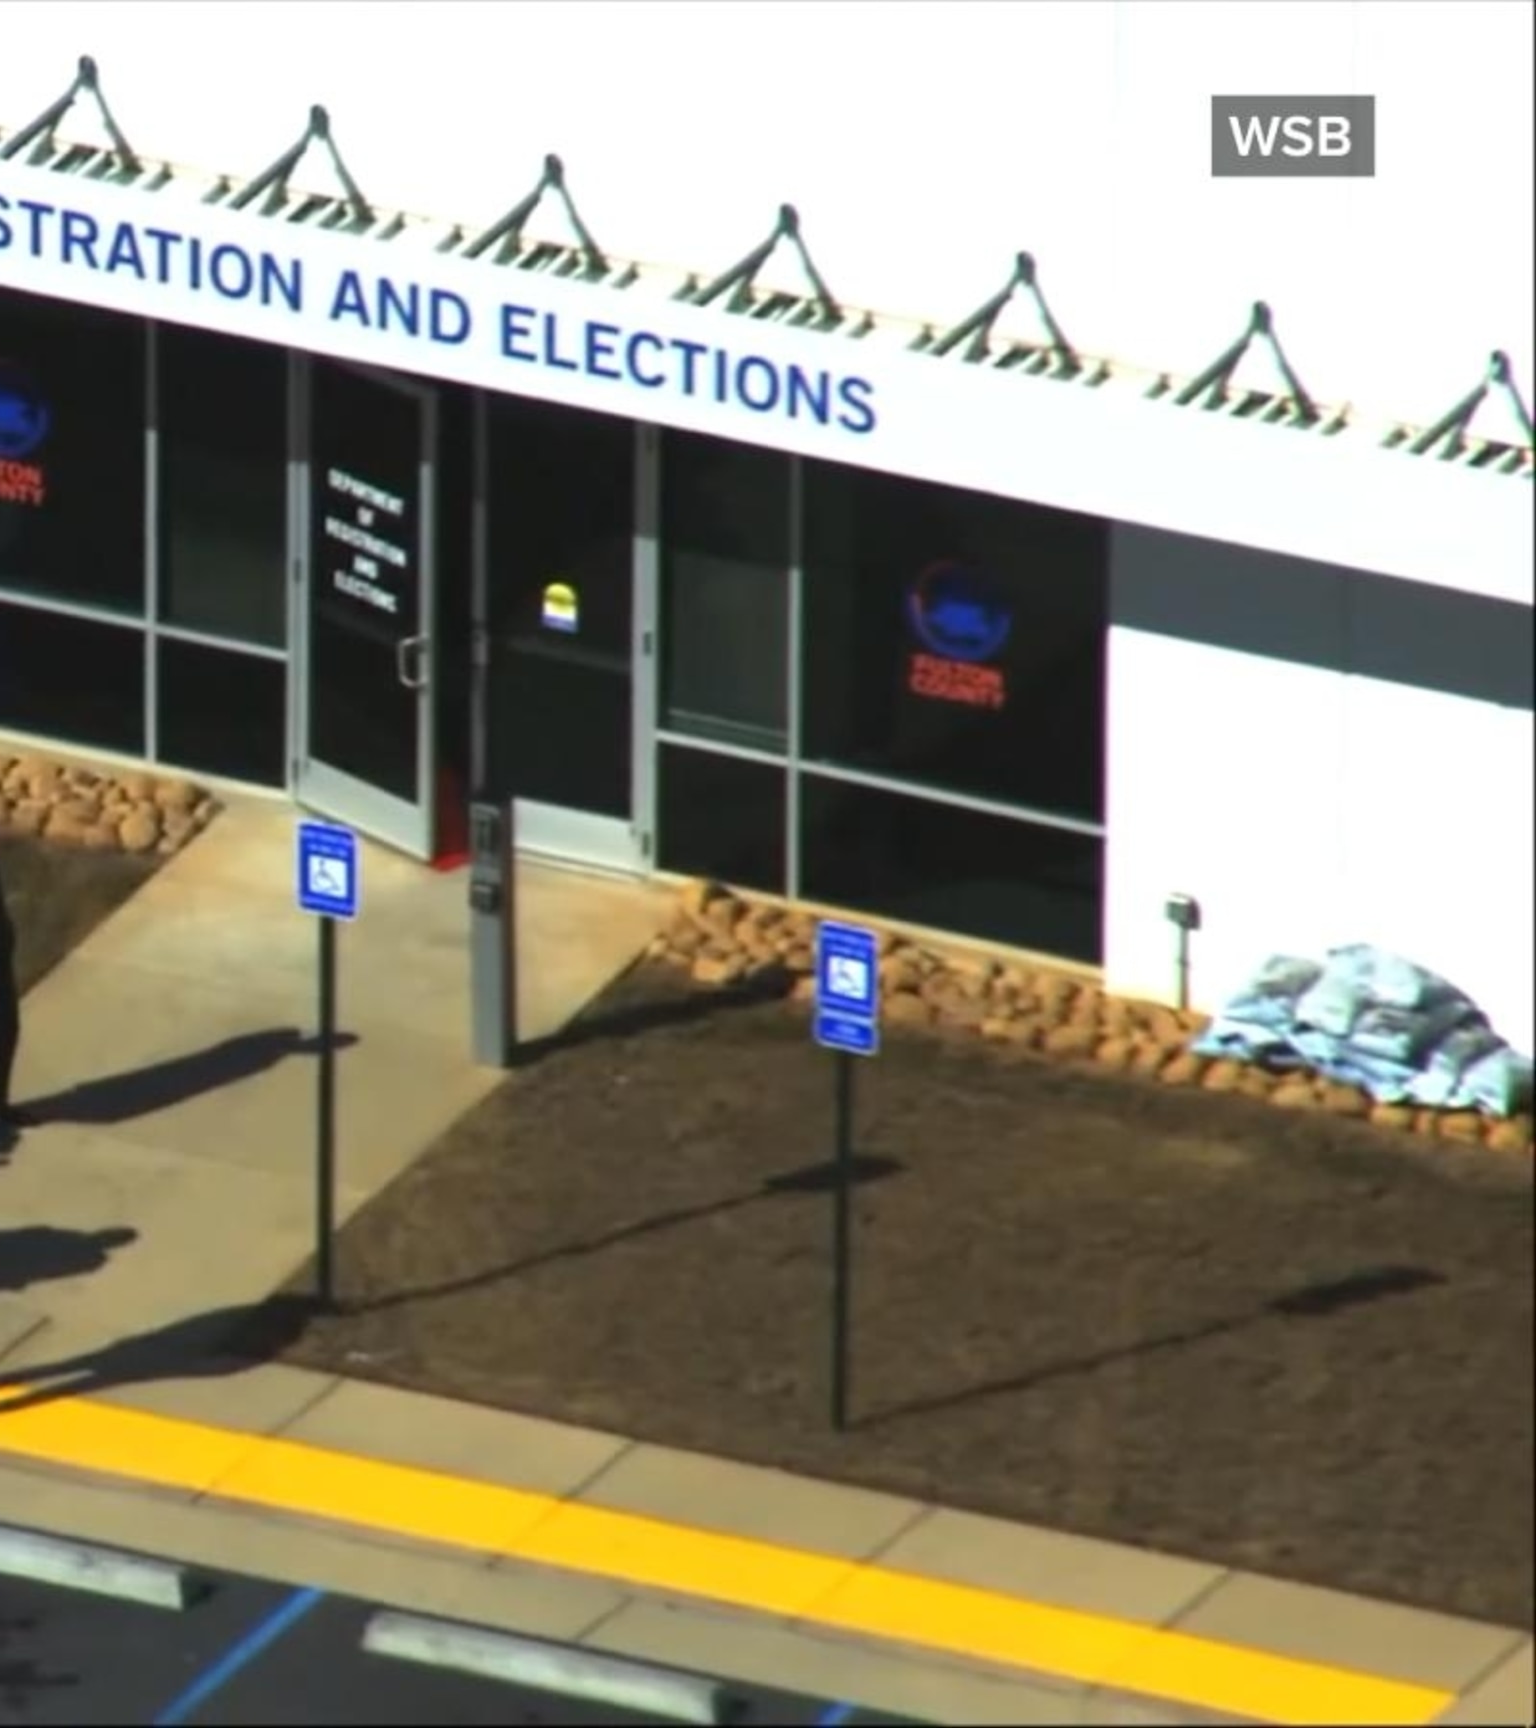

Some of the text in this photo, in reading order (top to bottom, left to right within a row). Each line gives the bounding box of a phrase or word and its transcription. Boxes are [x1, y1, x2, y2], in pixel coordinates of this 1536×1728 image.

[329, 270, 472, 346] AND
[499, 302, 878, 435] ELECTIONS
[327, 467, 404, 517] DEPARTMENT
[324, 515, 407, 568] REGISTRATION
[332, 569, 398, 614] ELECTIONS
